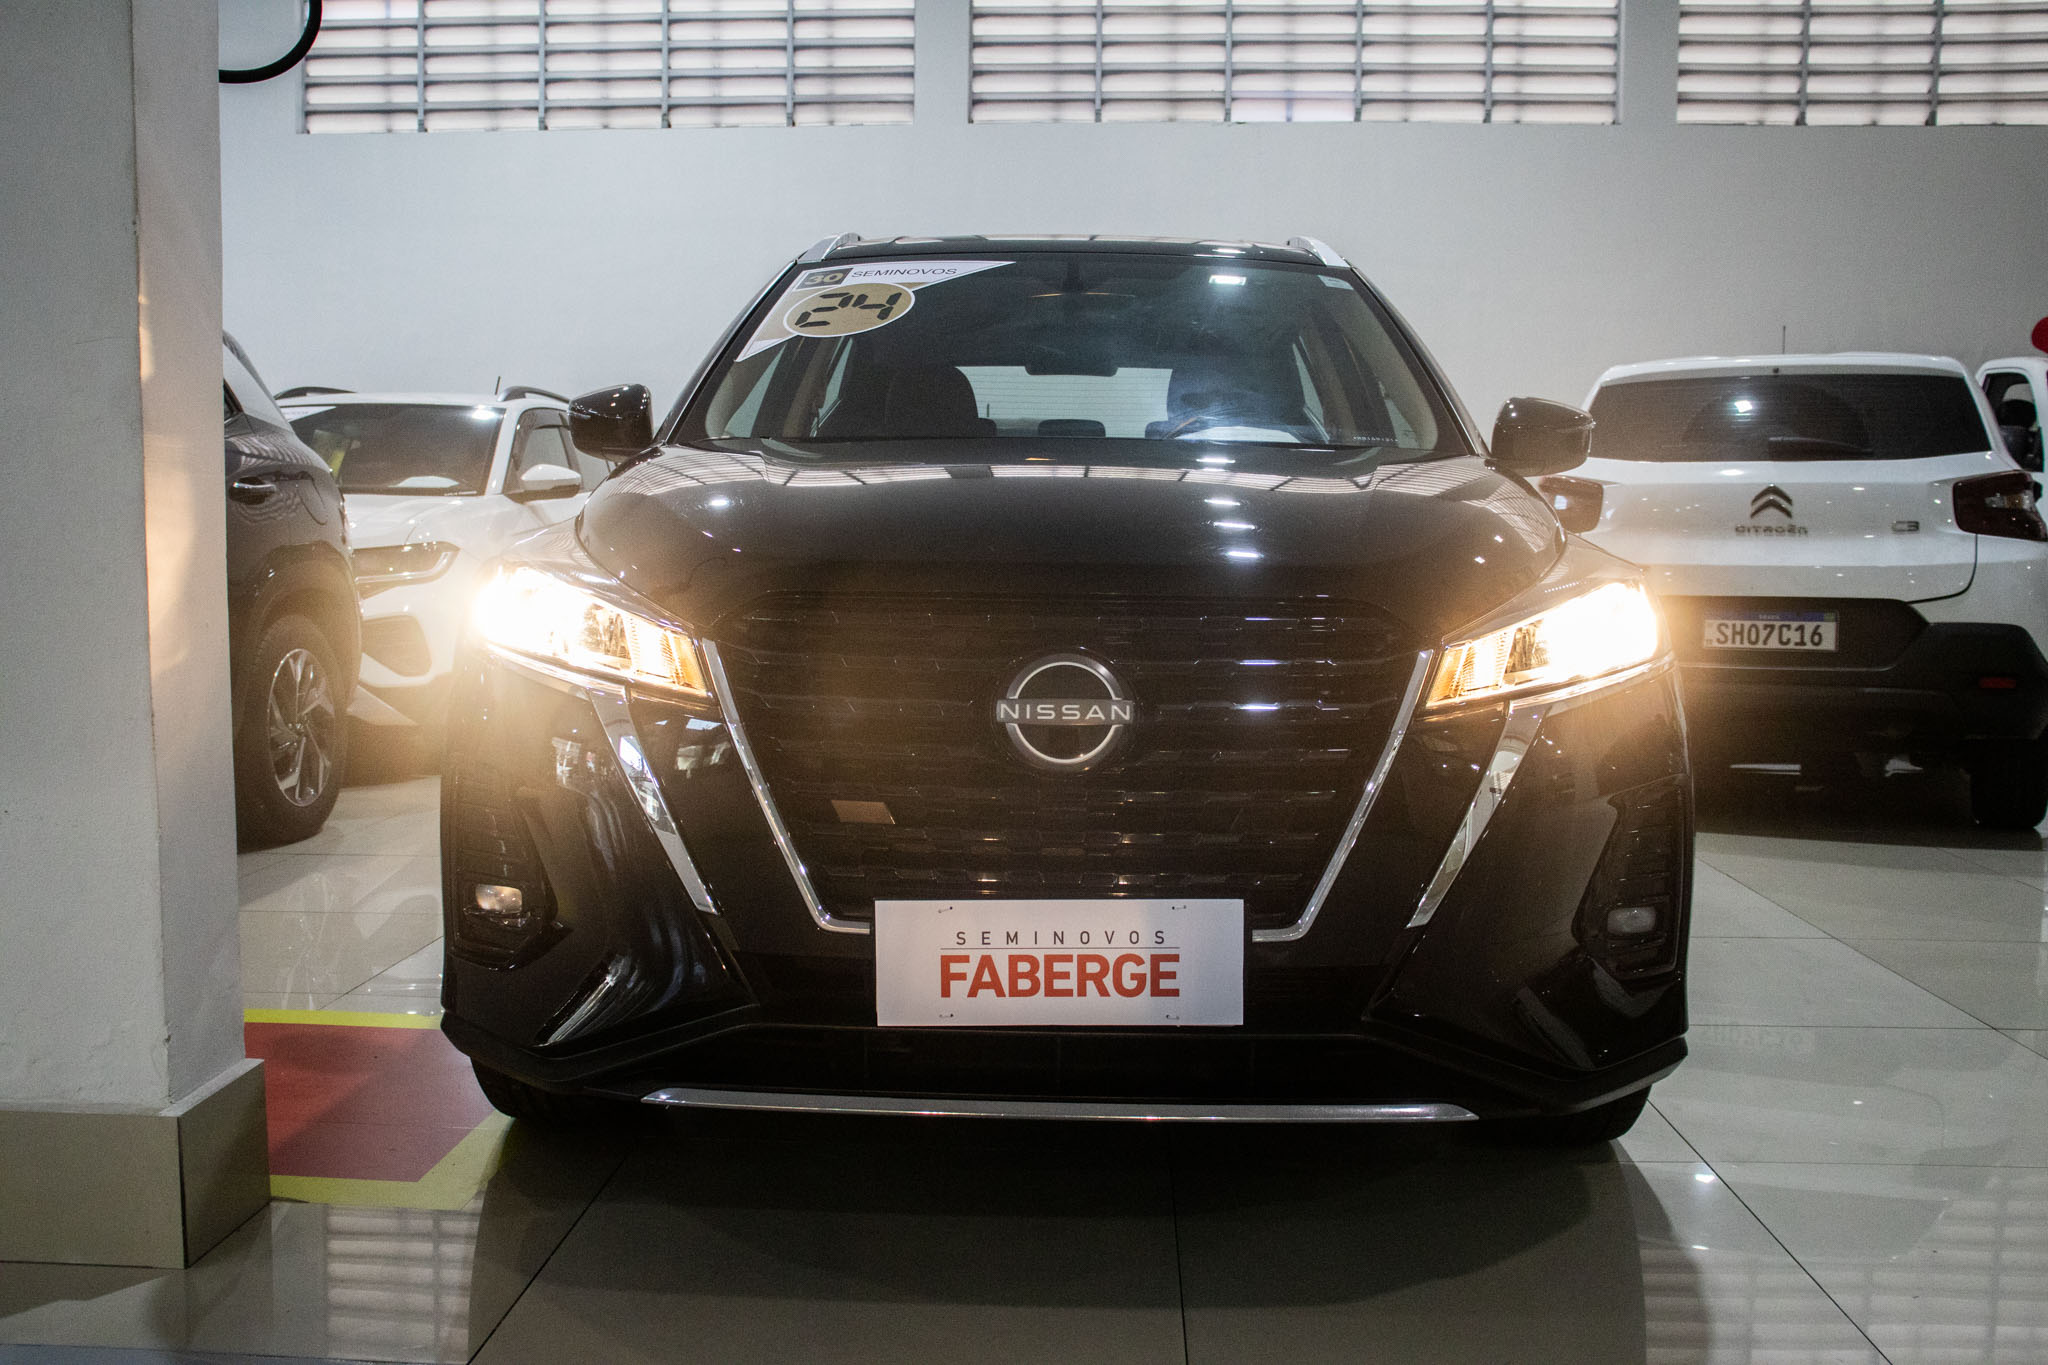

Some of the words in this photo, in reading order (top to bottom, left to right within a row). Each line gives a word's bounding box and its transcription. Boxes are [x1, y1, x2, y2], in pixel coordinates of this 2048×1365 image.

[804, 272, 844, 286] 30
[851, 267, 958, 278] SEMINOVOS
[794, 291, 903, 329] 24
[1892, 520, 1920, 533] C3
[1000, 703, 1131, 721] NISSAN
[956, 930, 1165, 945] SEMINOVOS
[940, 953, 1180, 998] FABERGE
